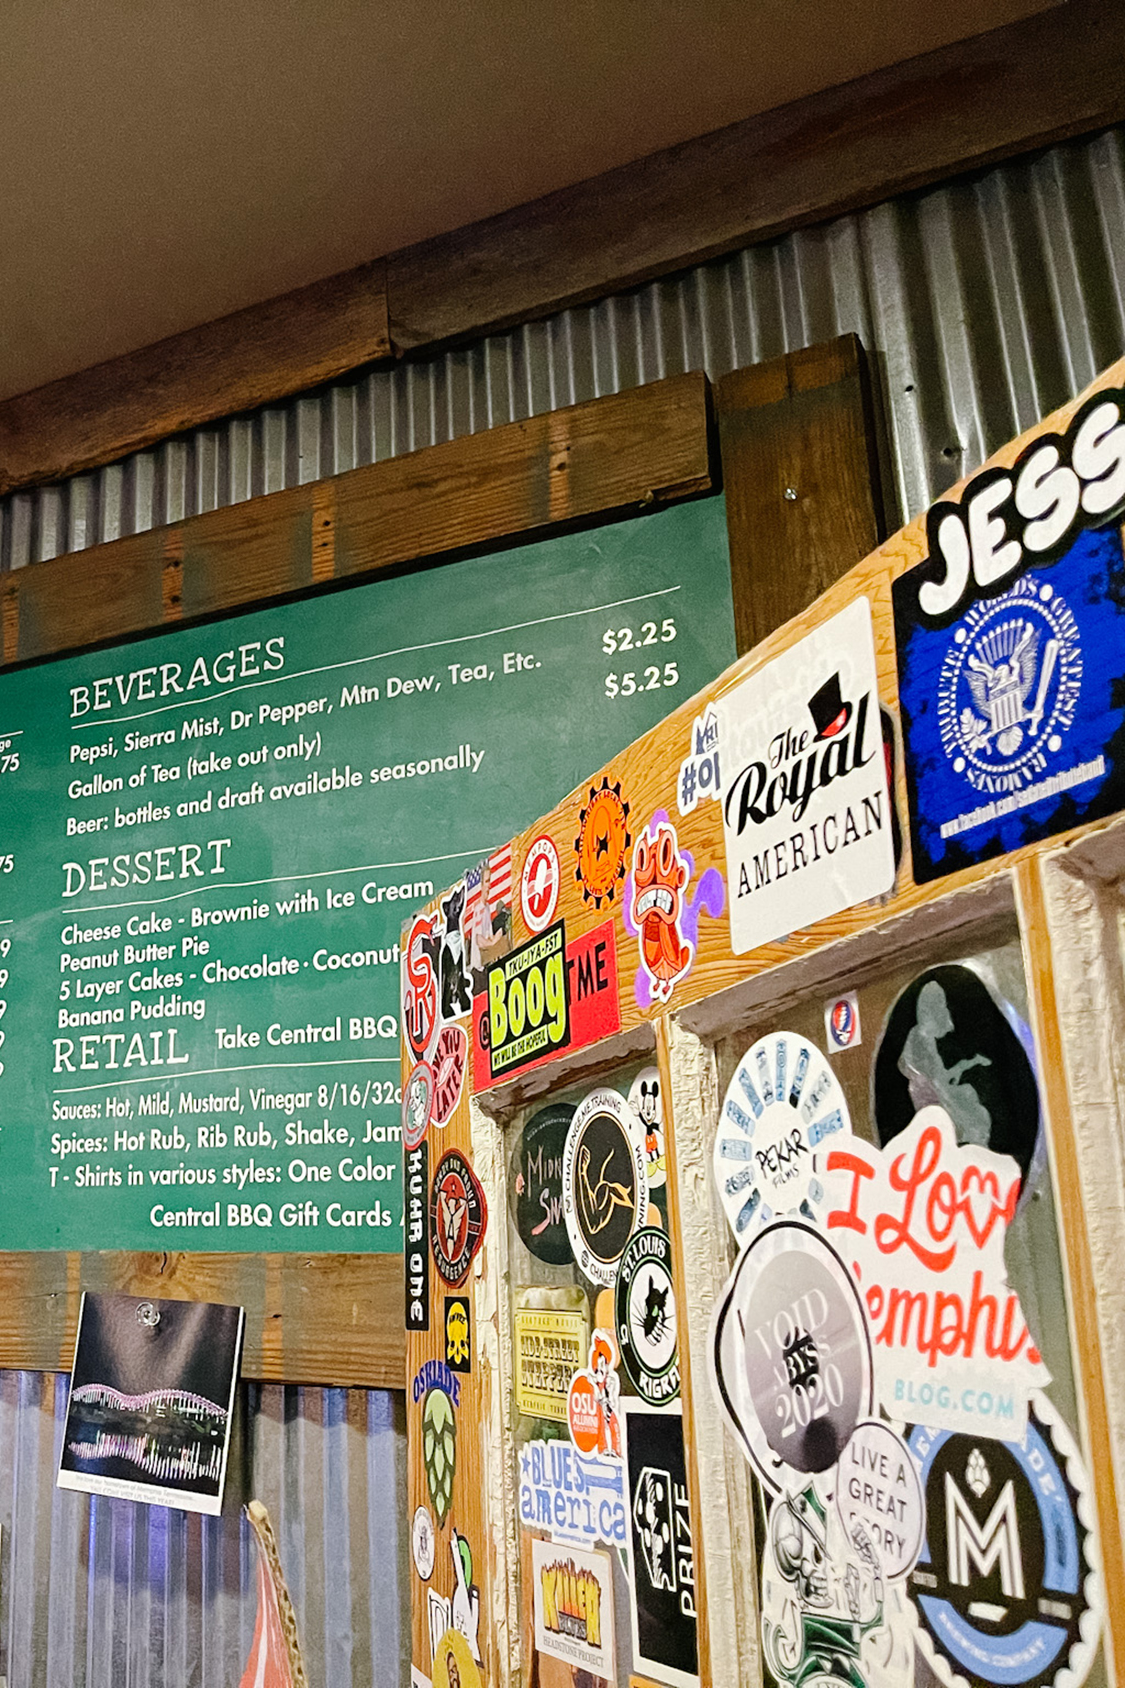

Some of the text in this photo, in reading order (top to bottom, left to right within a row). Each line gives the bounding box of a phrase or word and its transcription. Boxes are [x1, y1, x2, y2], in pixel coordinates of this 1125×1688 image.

[602, 618, 677, 655] $2.25
[70, 637, 285, 718] BEVERAGES
[605, 662, 679, 700] $5.25
[70, 652, 541, 765] Pepsi, Sierra Mist, Dr Pepper, Mtn Dew, Tea, Etc.
[725, 690, 876, 836] Royal
[769, 726, 809, 769] The
[62, 838, 231, 897] DESSERT
[737, 790, 883, 899] AMERICAN
[60, 936, 210, 972] Peanut Butter Pie
[58, 994, 205, 1028] Banana Pudding
[53, 1015, 397, 1073] RETAIL Take Central BBQ
[437, 1054, 463, 1122] LATER
[527, 1144, 563, 1198] MIDN
[755, 1128, 809, 1180] PEKAR
[772, 1165, 800, 1189] FILMS
[150, 1200, 392, 1227] Central BBQ Gift Cards
[827, 1151, 875, 1235] I
[633, 1235, 666, 1260] LOUIS
[410, 1253, 424, 1323] ONE
[572, 1392, 597, 1415] OSU
[775, 1364, 844, 1439] 2020
[894, 1378, 1015, 1419] BLOG.COM
[851, 1441, 907, 1487] LIVE A
[848, 1477, 907, 1524] GREAT
[850, 1512, 906, 1559] ORY
[543, 1635, 604, 1668] HEADSTONE PROJECT
